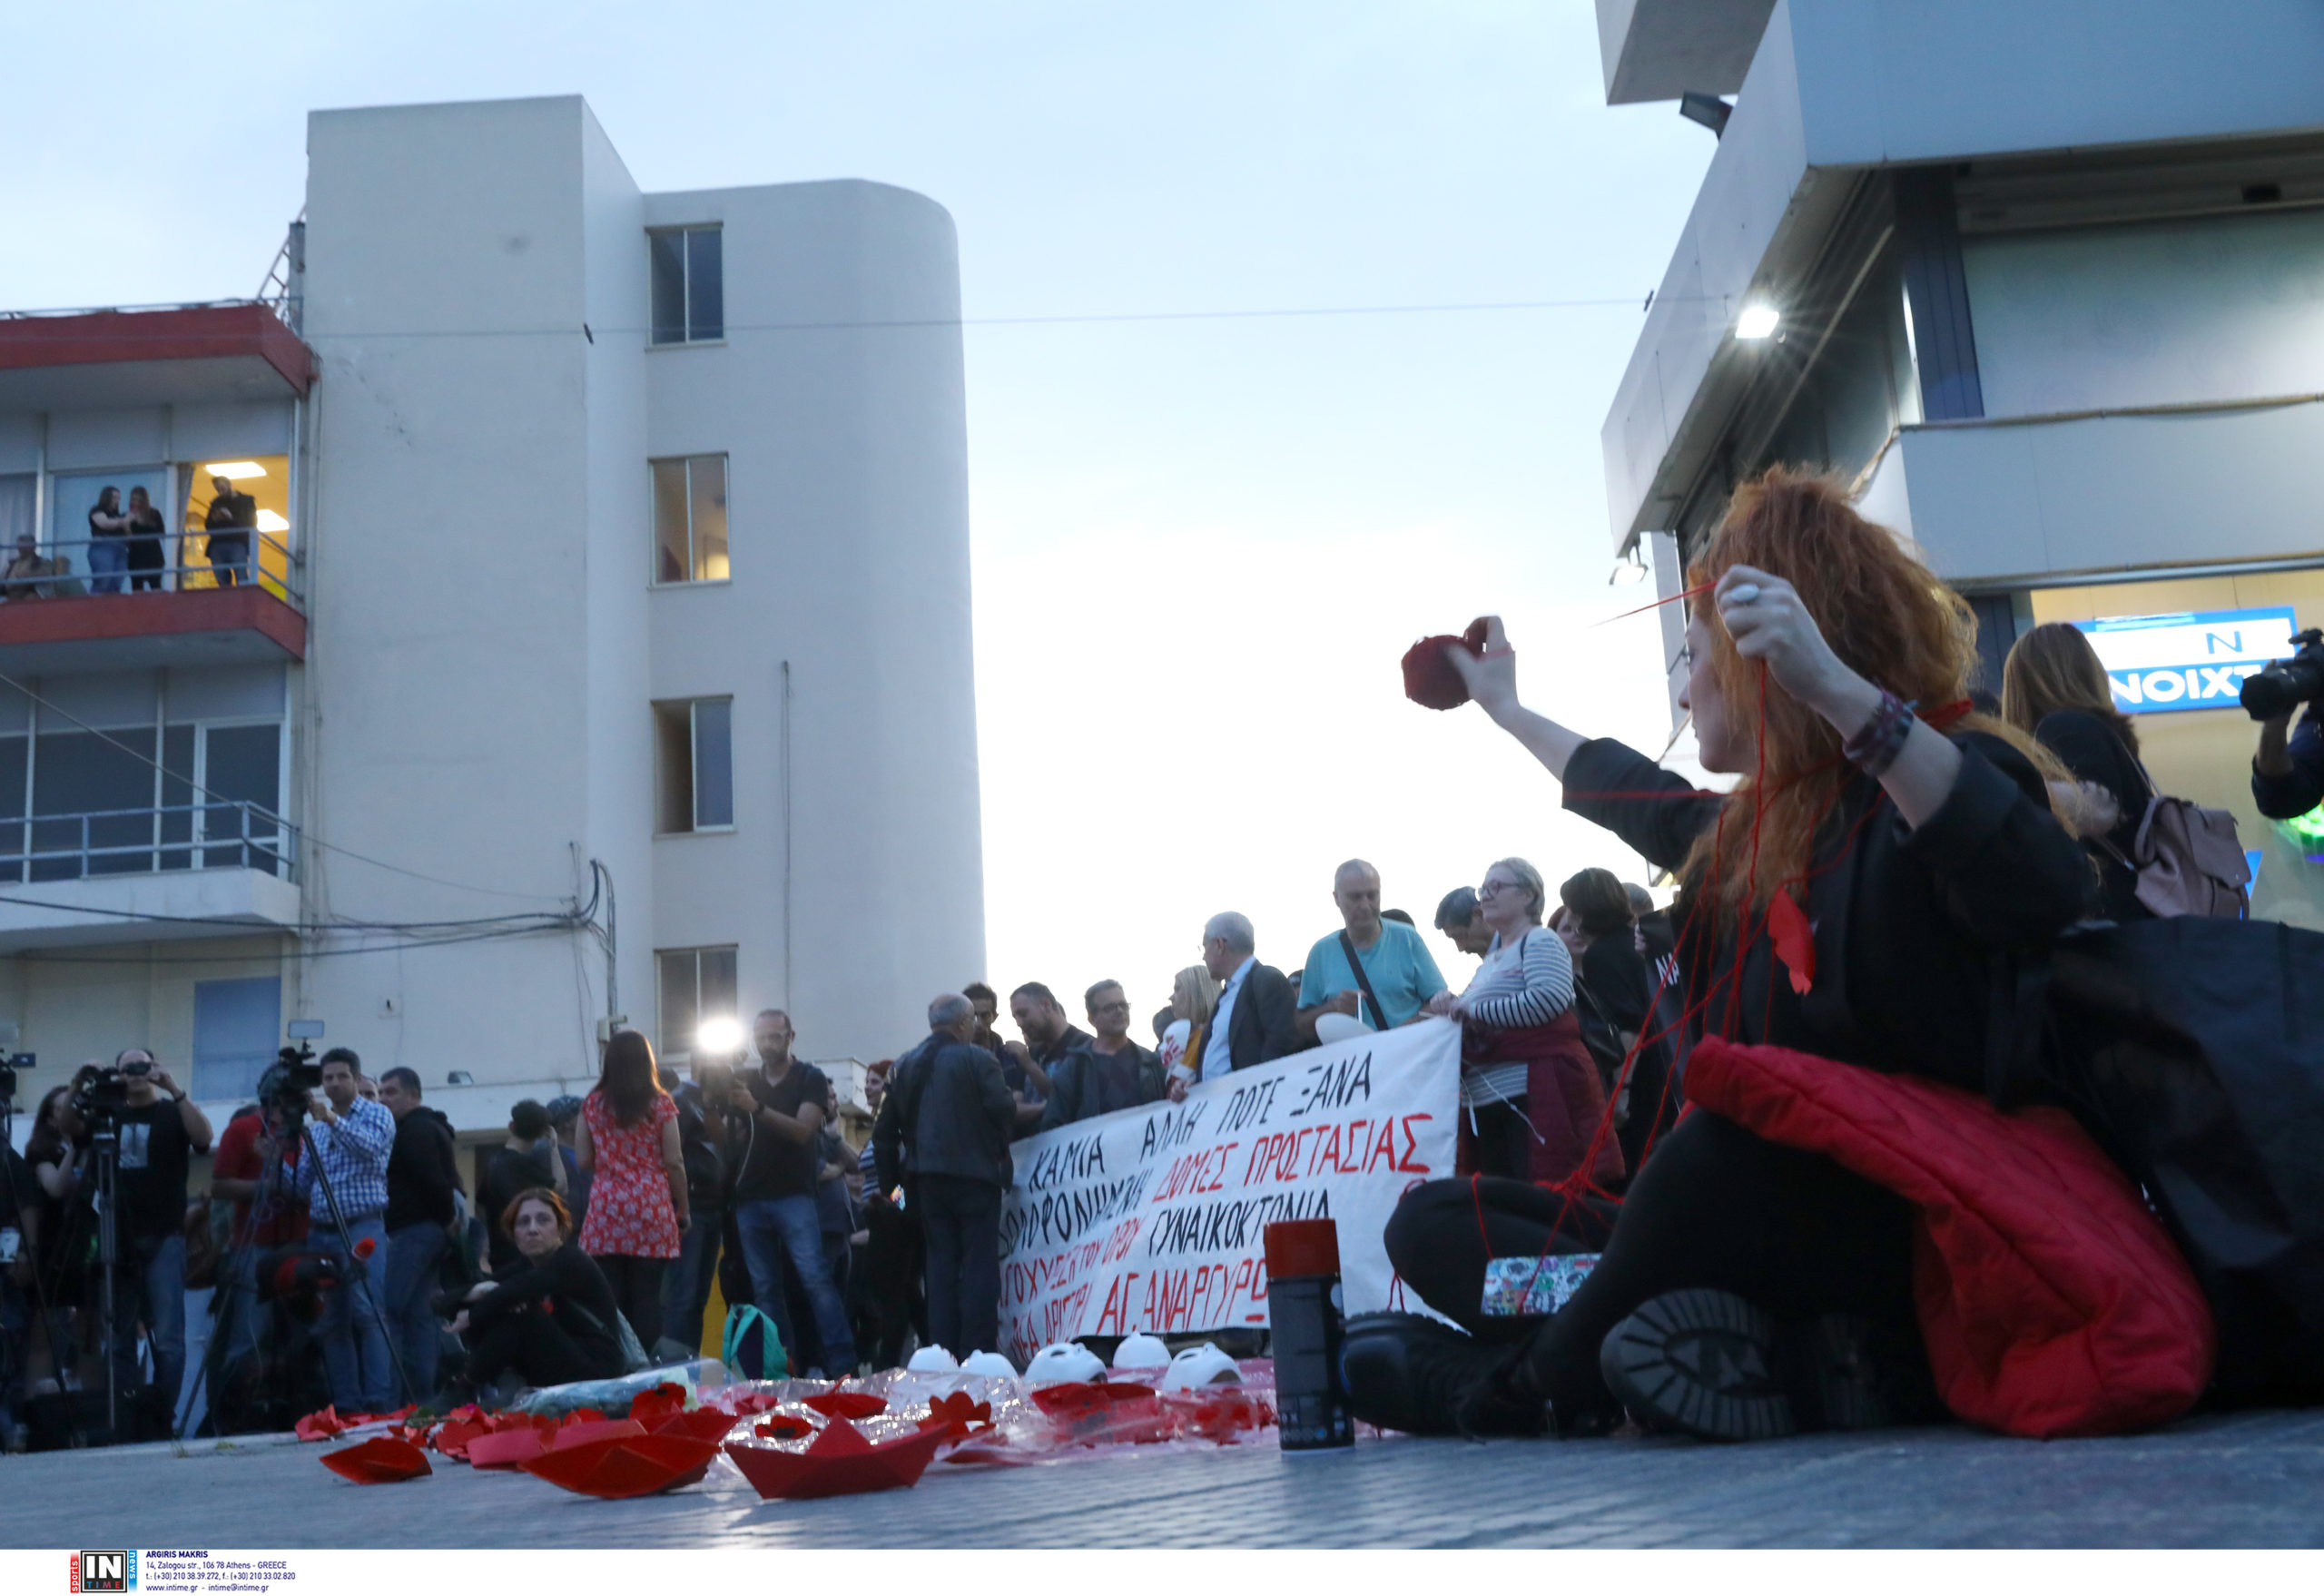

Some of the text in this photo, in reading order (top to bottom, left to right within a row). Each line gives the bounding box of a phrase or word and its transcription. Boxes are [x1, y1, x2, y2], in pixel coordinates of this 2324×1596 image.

[1029, 1050, 1373, 1194] ΚΑΜΙΑ ΑΛΛΗ ΠΟΤΕ ΞΑΝΑ
[1151, 1141, 1239, 1204] ΔΟΜΕΣ
[1244, 1112, 1433, 1187] ΠΡΟΣΤΑΣΙΑΣ
